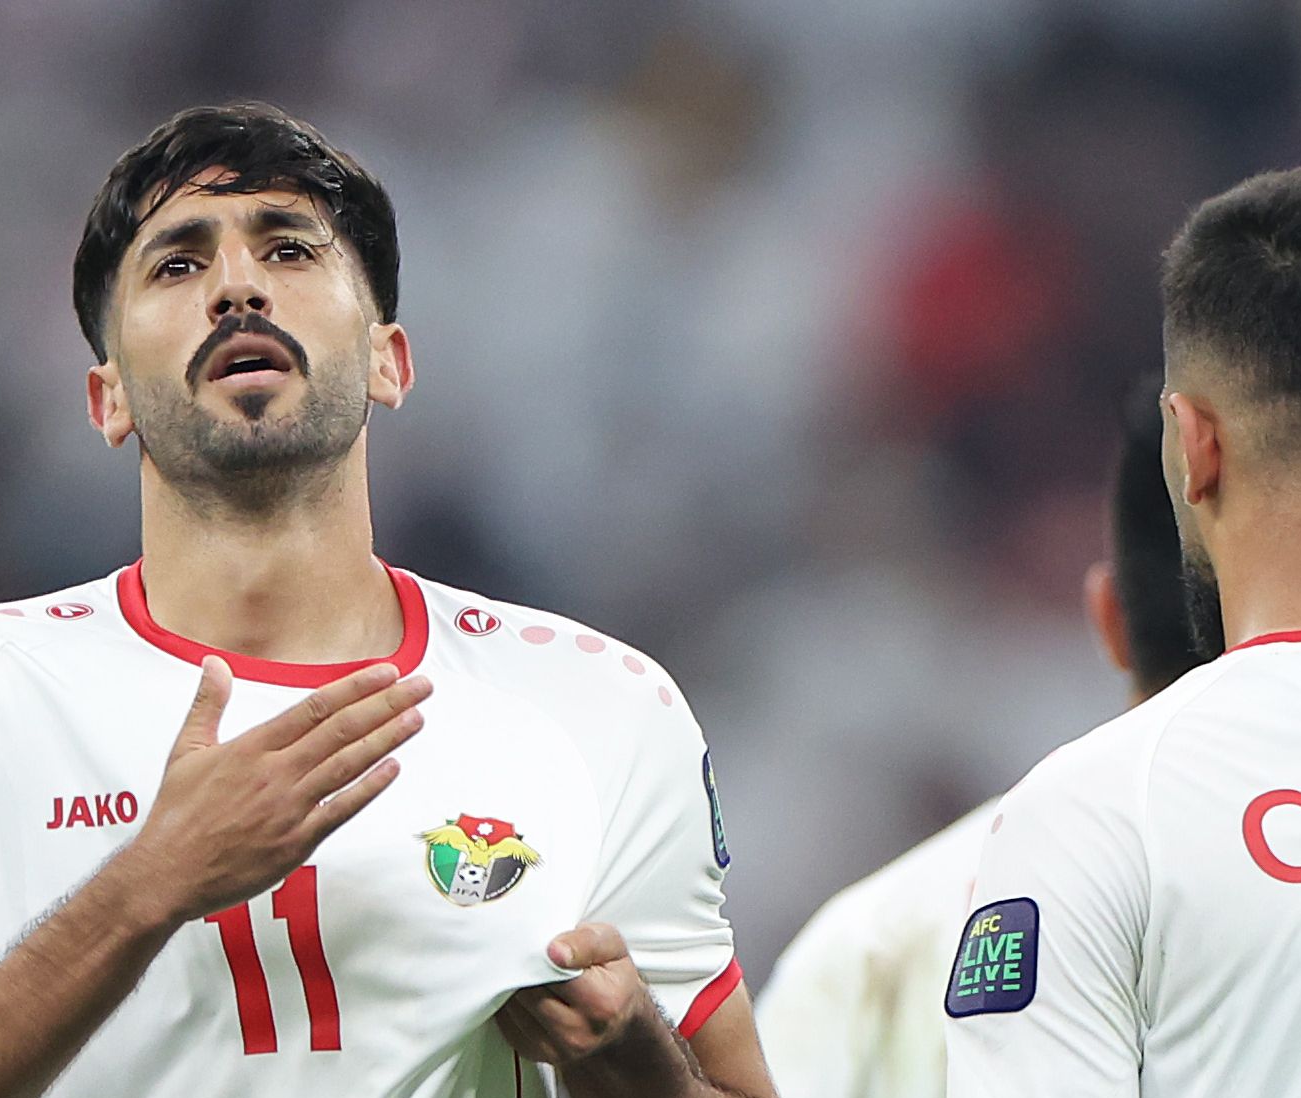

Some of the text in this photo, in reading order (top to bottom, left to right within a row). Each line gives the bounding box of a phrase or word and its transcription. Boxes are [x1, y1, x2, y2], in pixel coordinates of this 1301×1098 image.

[46, 791, 139, 830] JAKO
[969, 914, 1002, 939] AFC
[204, 865, 342, 1055] 11
[962, 932, 1024, 969] LIVE
